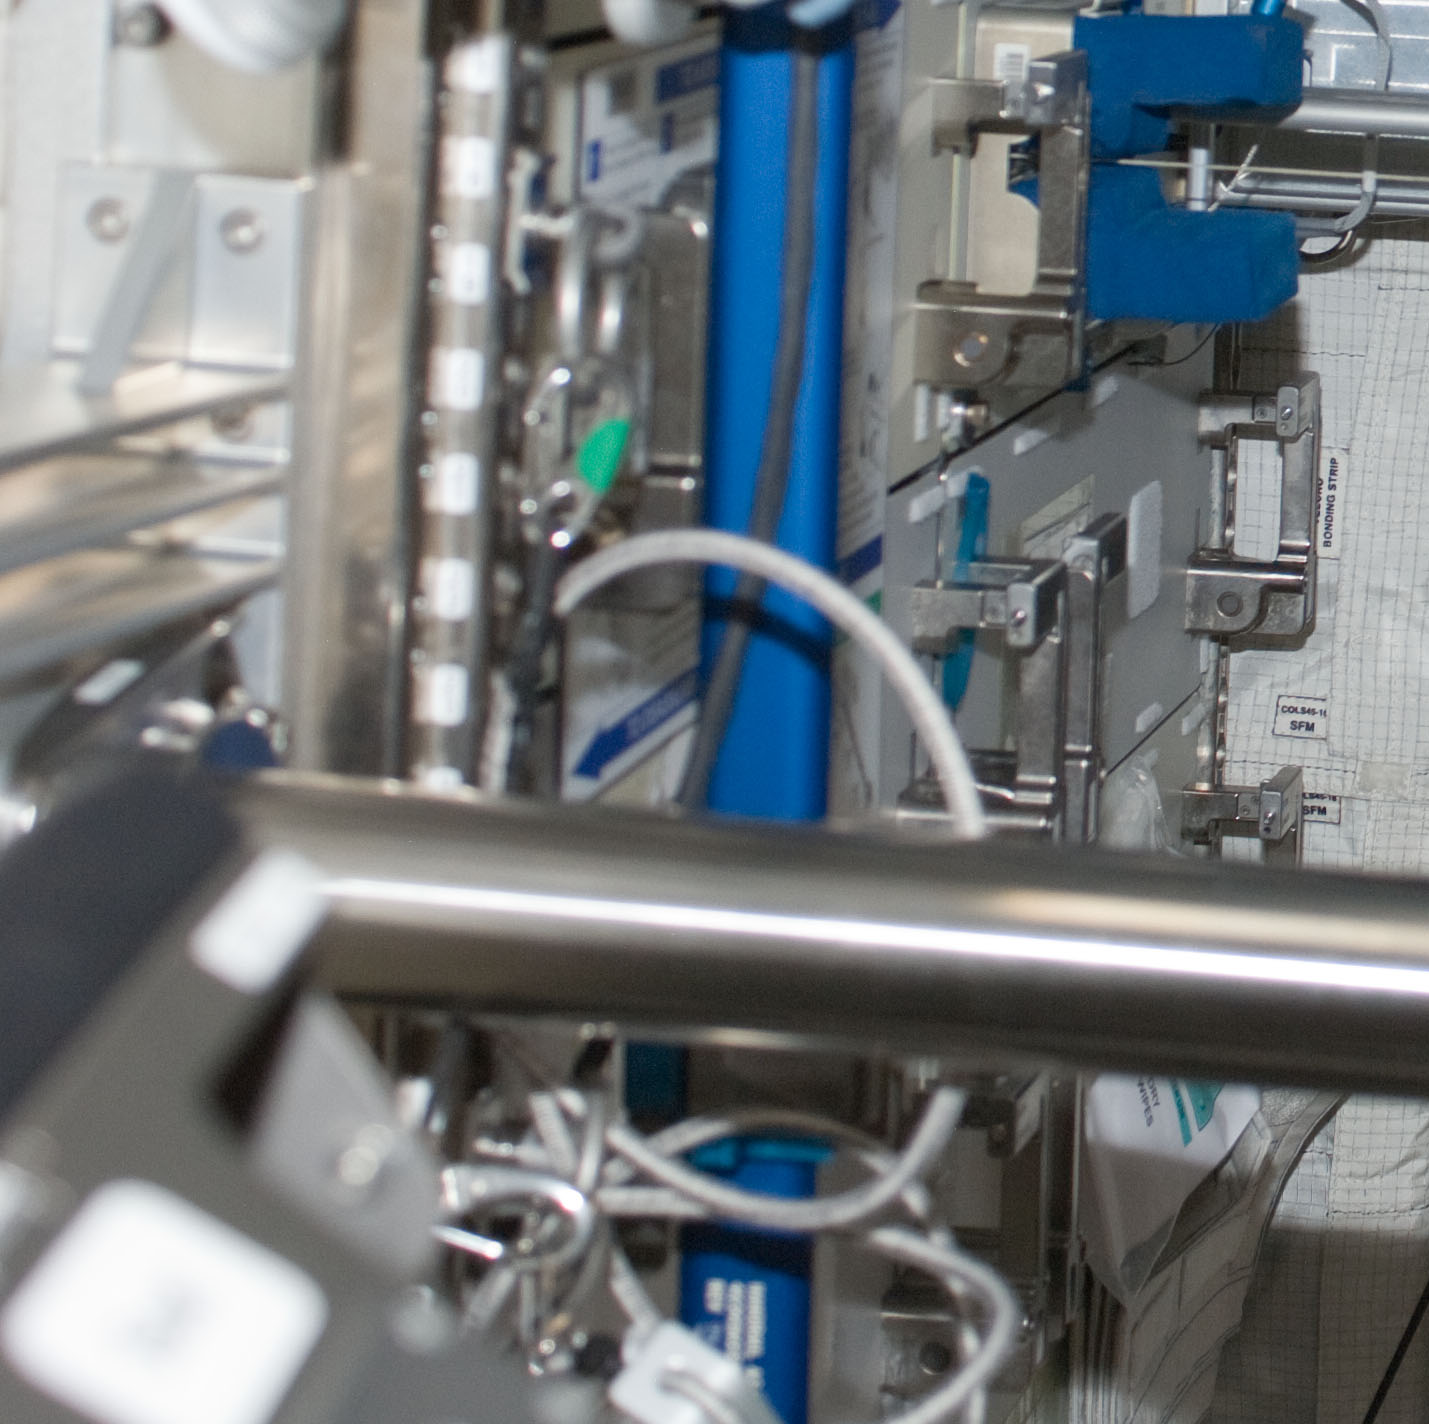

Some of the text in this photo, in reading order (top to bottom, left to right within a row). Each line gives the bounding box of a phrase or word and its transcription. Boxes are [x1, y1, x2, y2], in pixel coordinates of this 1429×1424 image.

[1322, 457, 1338, 548] BONDING STRIP
[1290, 720, 1315, 732] SFM
[1303, 805, 1327, 816] SFM
